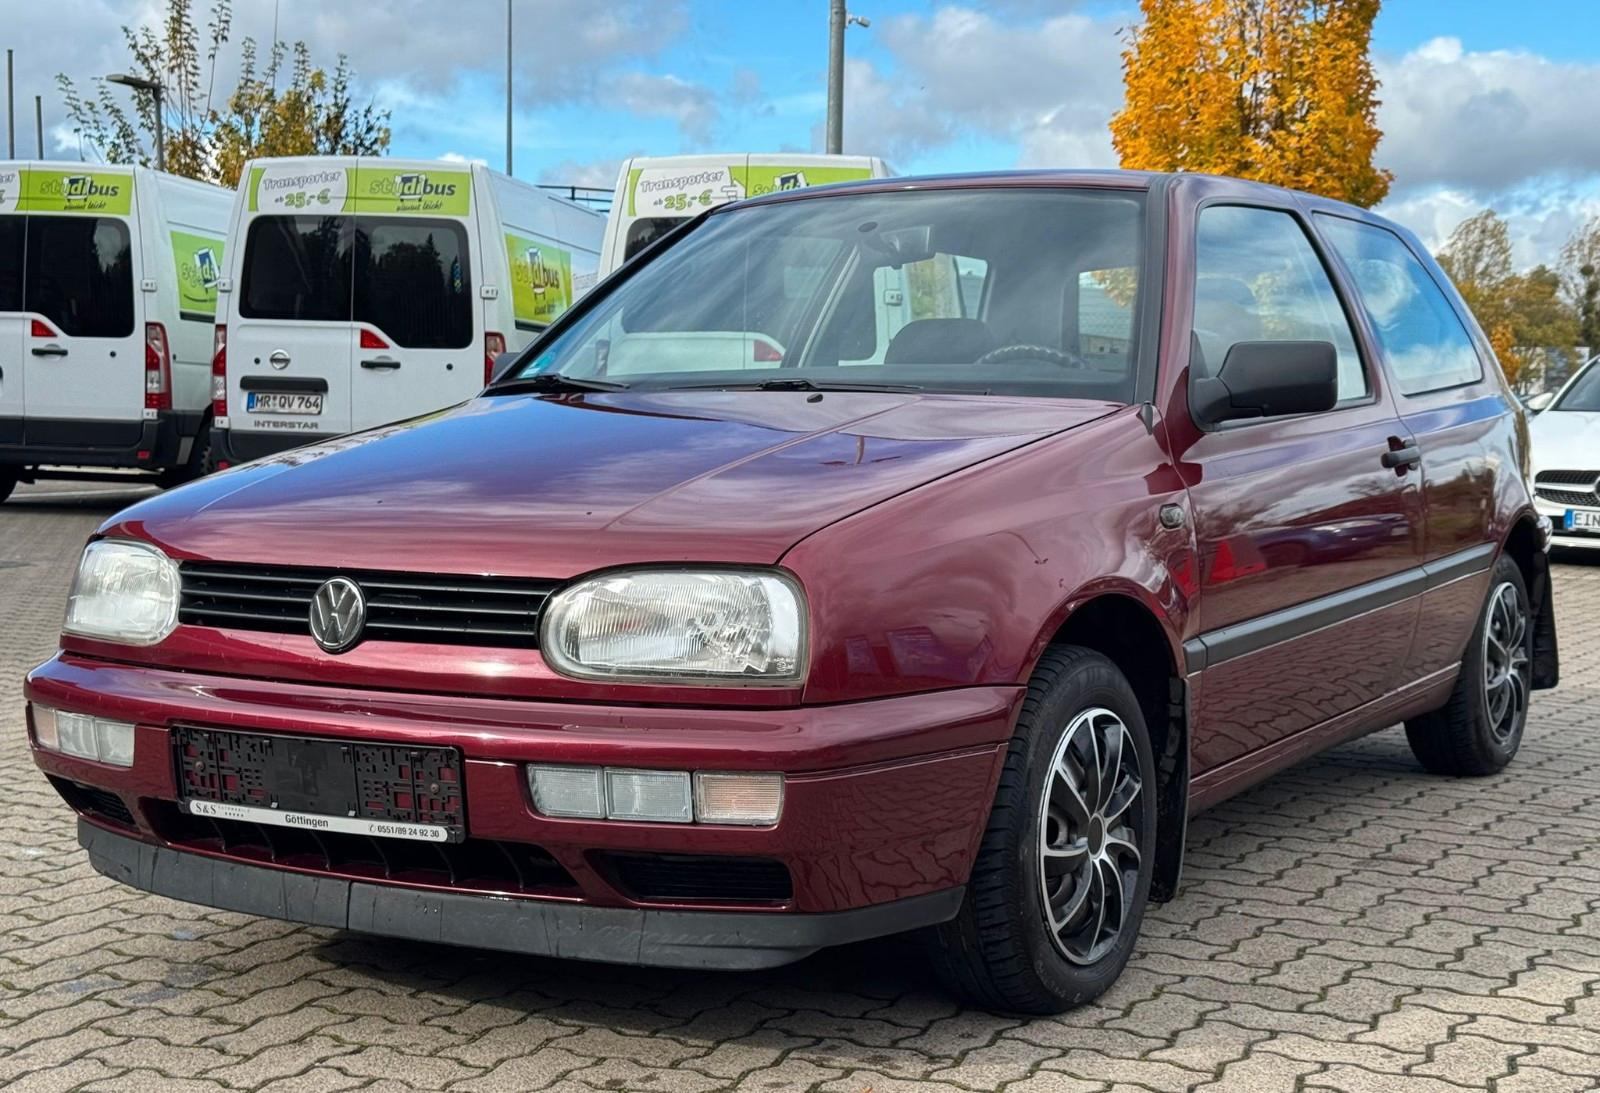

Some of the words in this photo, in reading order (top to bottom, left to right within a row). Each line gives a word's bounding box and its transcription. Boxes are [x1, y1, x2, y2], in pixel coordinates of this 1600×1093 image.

[263, 171, 342, 190] Transporter
[640, 170, 723, 192] Transporter
[278, 395, 296, 409] QV
[297, 396, 320, 409] 764
[254, 420, 319, 430] INTERSTAR
[285, 814, 329, 828] Göttingen
[408, 826, 418, 836] 24
[419, 827, 429, 837] 92
[430, 829, 440, 838] 30
